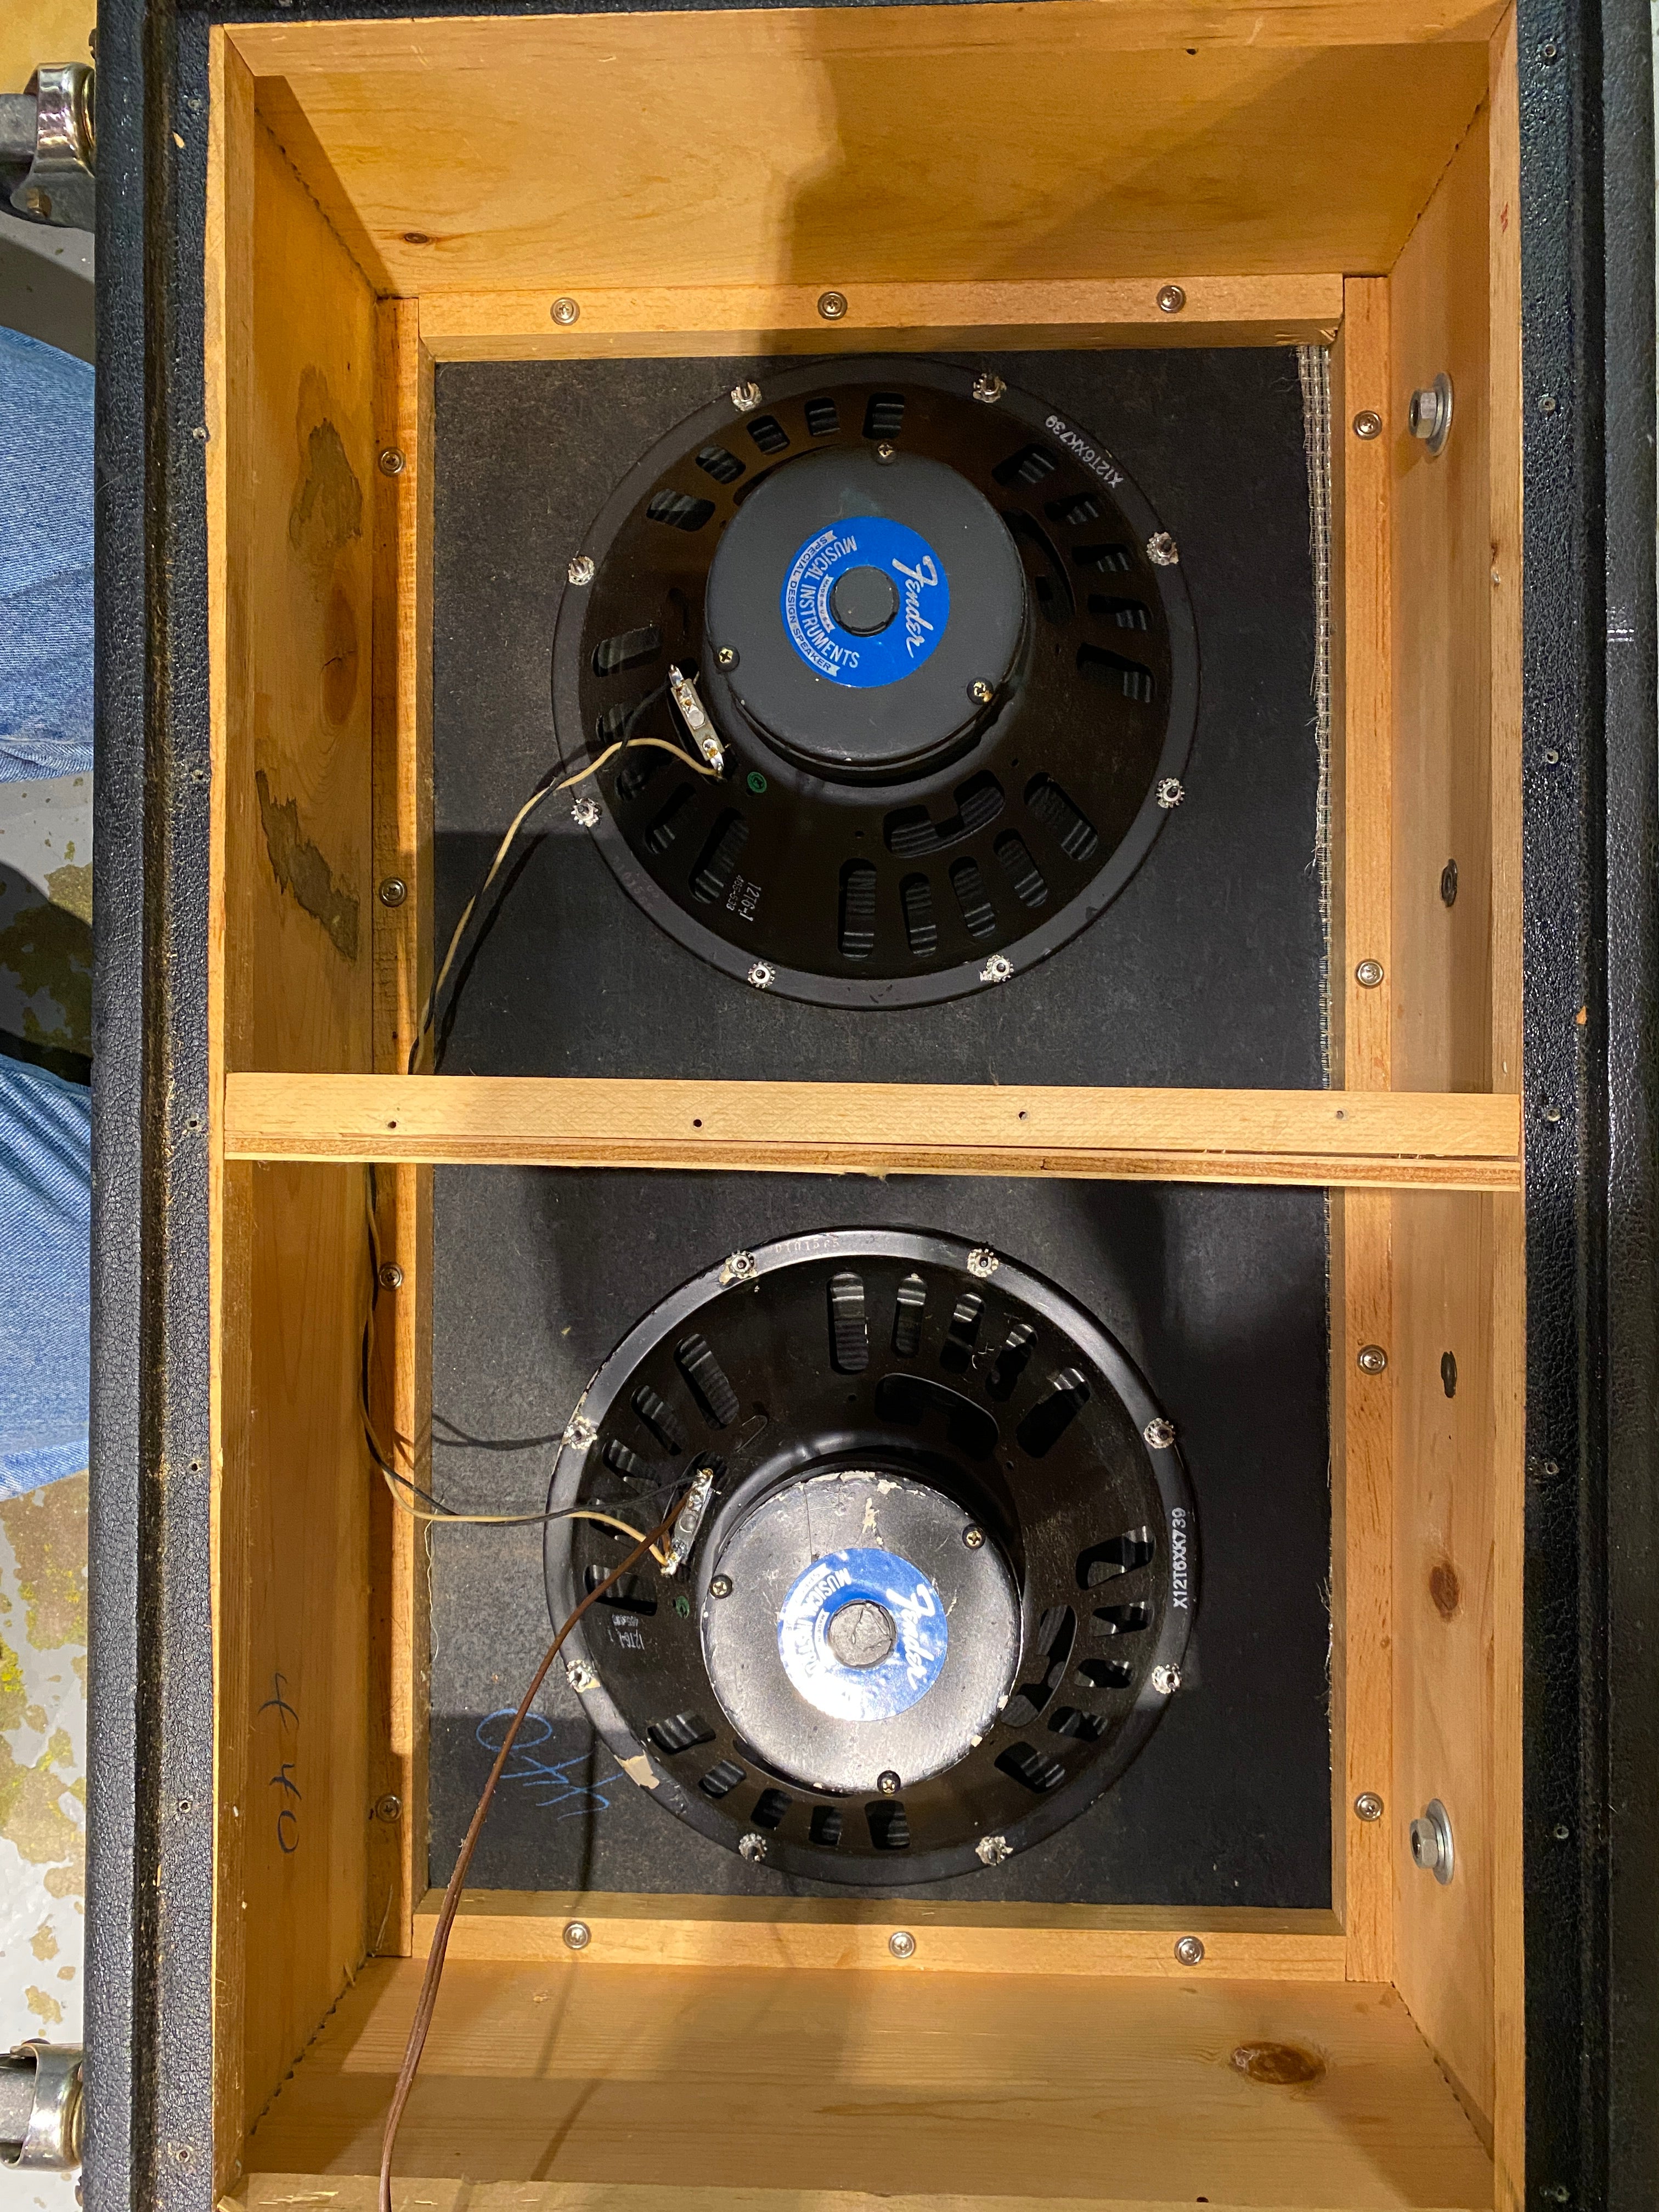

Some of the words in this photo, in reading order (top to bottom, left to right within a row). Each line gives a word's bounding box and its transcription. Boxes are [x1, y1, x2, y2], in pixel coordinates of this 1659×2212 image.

[793, 536, 828, 577] SPECIAL
[804, 535, 857, 579] MUSICAL
[788, 581, 797, 624] DESIGN
[820, 579, 830, 597] MADE
[891, 555, 939, 658] Fender
[799, 584, 860, 668] INSTRUMENTS
[793, 629, 831, 672] SPEAKER
[1171, 1507, 1188, 1609] X12T6XK739
[886, 1584, 935, 1690] Fender
